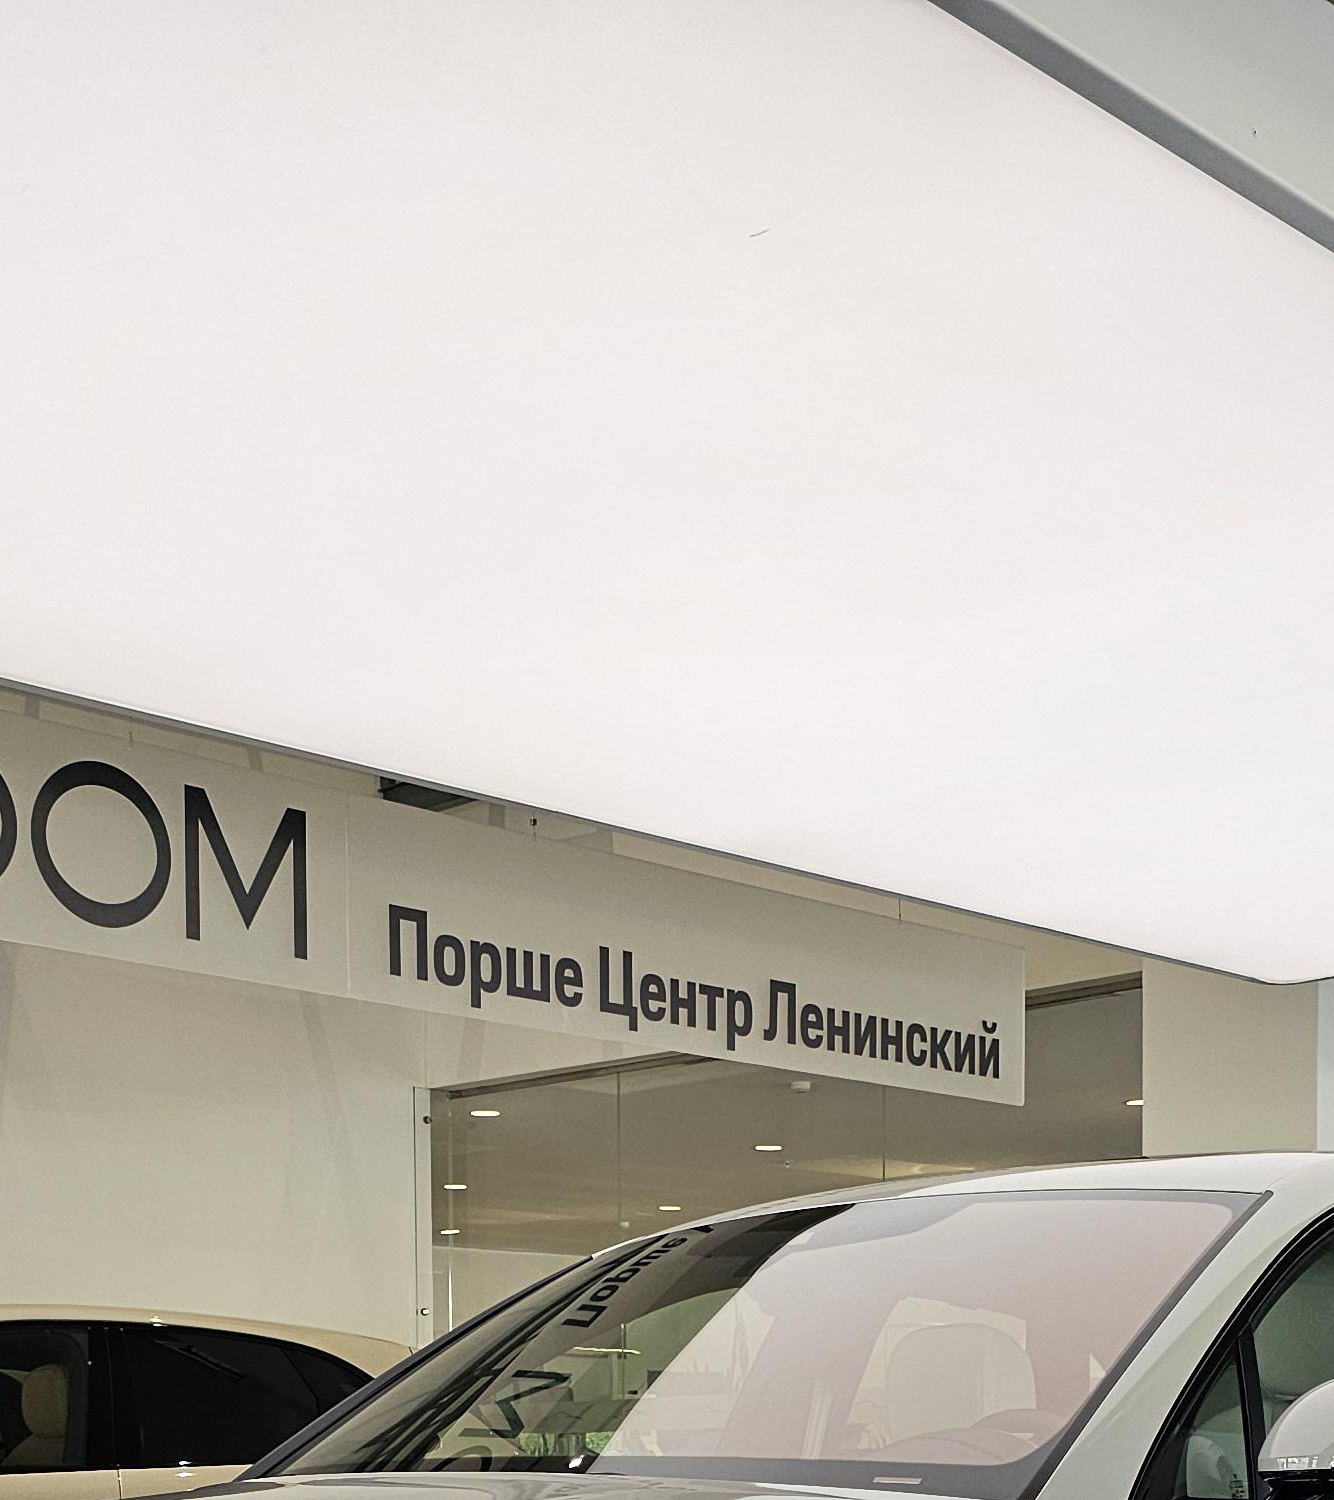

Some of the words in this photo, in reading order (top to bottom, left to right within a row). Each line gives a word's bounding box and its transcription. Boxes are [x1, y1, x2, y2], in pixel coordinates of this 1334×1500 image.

[388, 903, 584, 1008] Порше
[598, 945, 753, 1051] Центр
[763, 978, 1002, 1079] Ленинский
